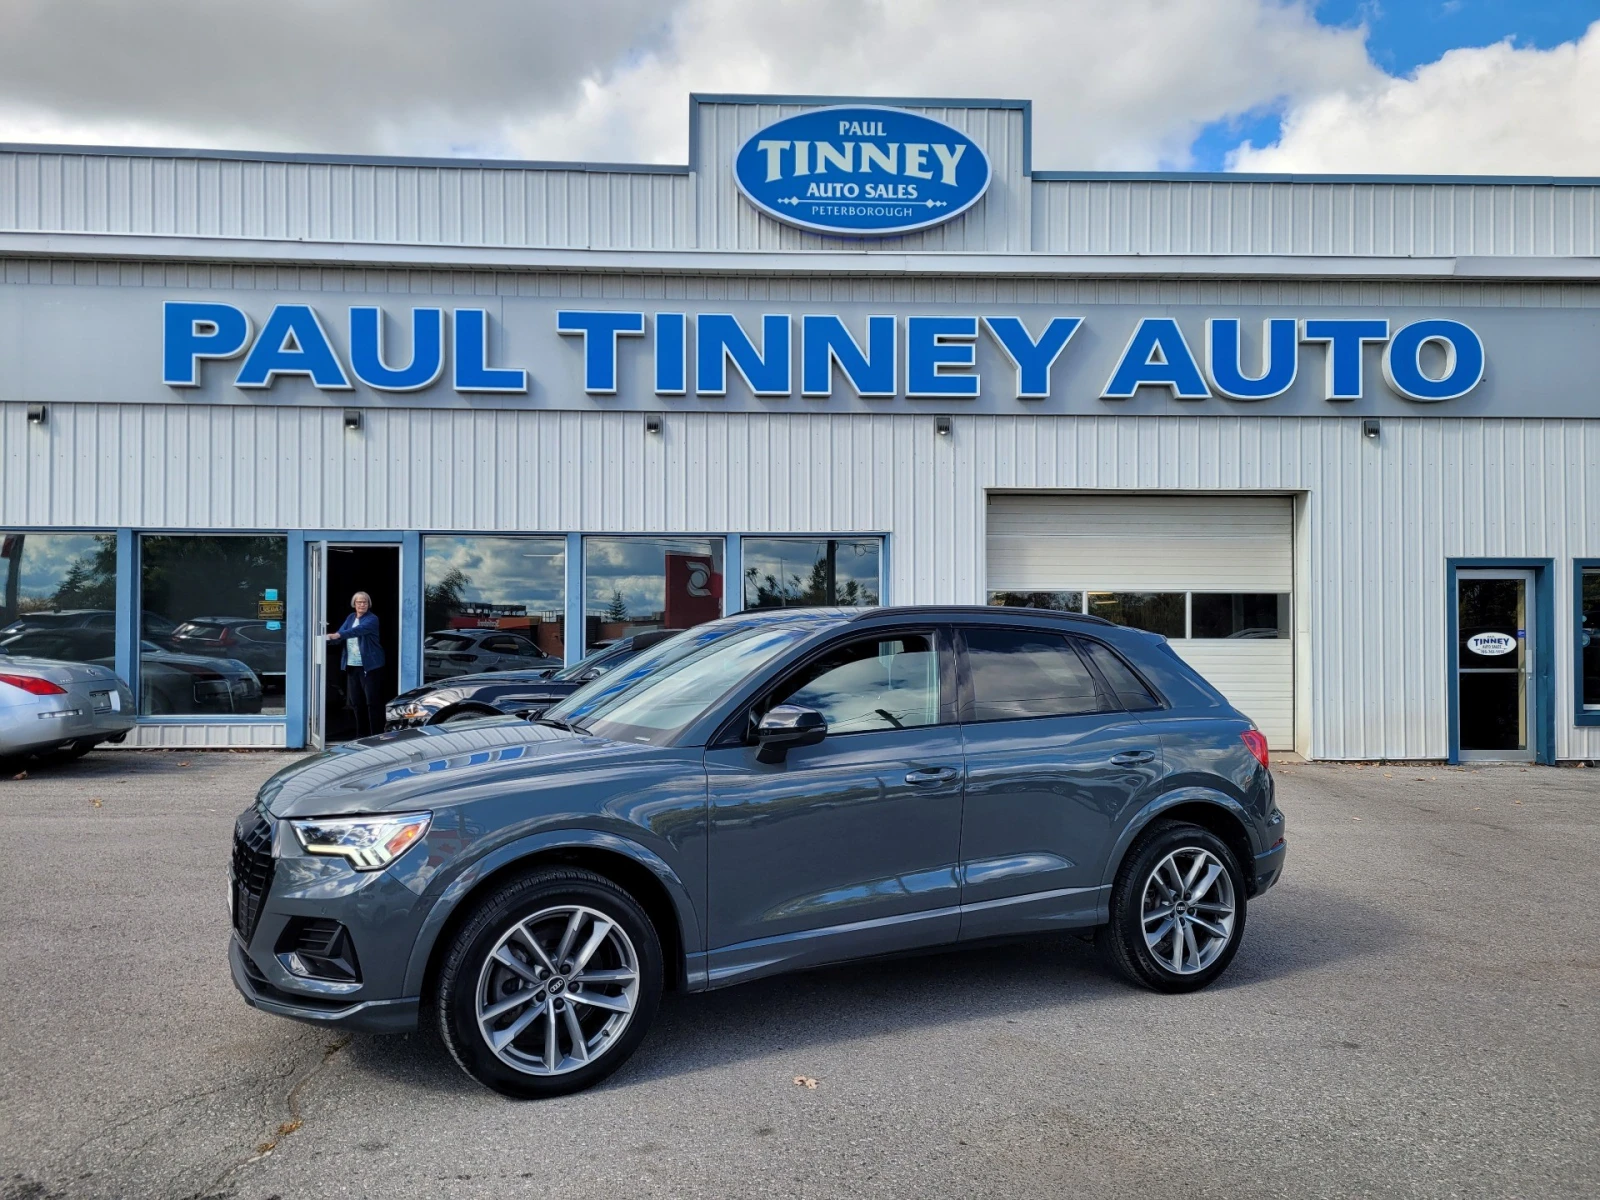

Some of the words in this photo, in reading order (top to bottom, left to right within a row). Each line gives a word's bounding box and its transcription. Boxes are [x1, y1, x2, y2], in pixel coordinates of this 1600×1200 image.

[839, 121, 887, 136] PAUL
[757, 140, 967, 187] TINNEY
[806, 182, 860, 198] AUTO
[864, 183, 918, 199] SALES
[812, 206, 913, 217] PETERBOROUGH
[163, 301, 528, 394] PAUL
[557, 309, 1086, 398] TINNEY
[1100, 316, 1486, 402] AUTO
[1474, 638, 1509, 646] TINNEY
